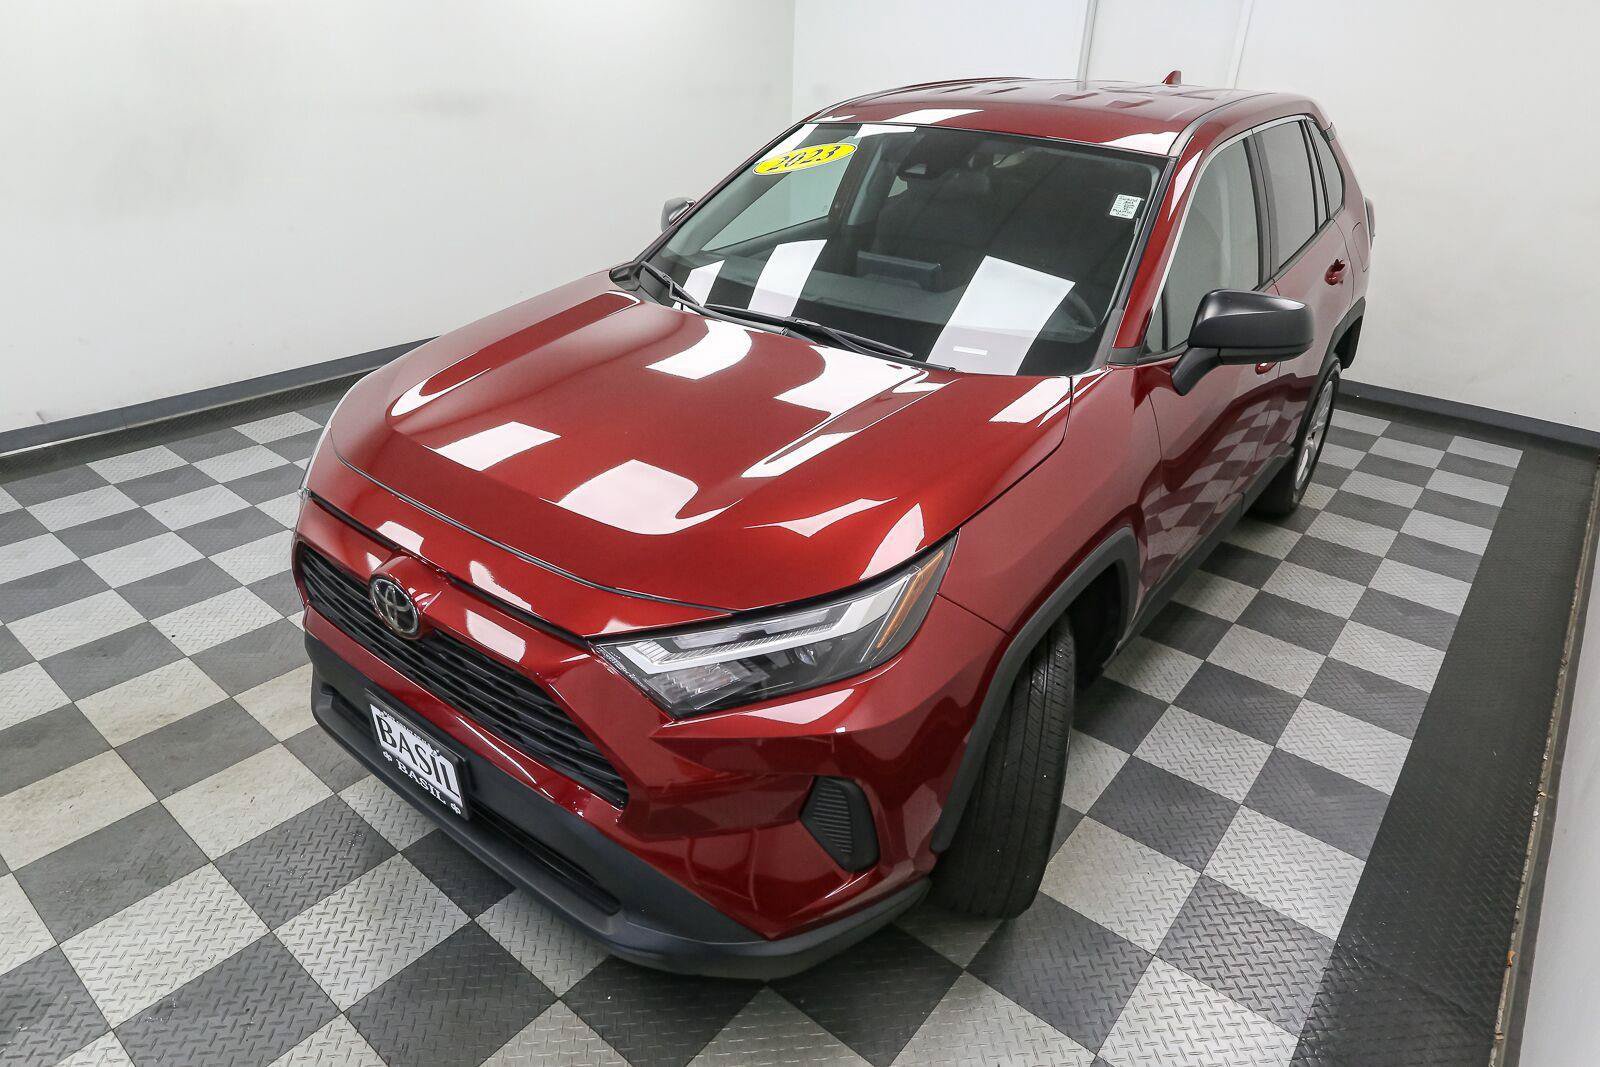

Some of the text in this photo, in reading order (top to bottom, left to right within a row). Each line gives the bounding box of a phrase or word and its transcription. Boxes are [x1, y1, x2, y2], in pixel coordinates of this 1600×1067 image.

[766, 145, 841, 172] 2023
[376, 715, 461, 798] BASIL
[396, 759, 447, 805] BASIL
